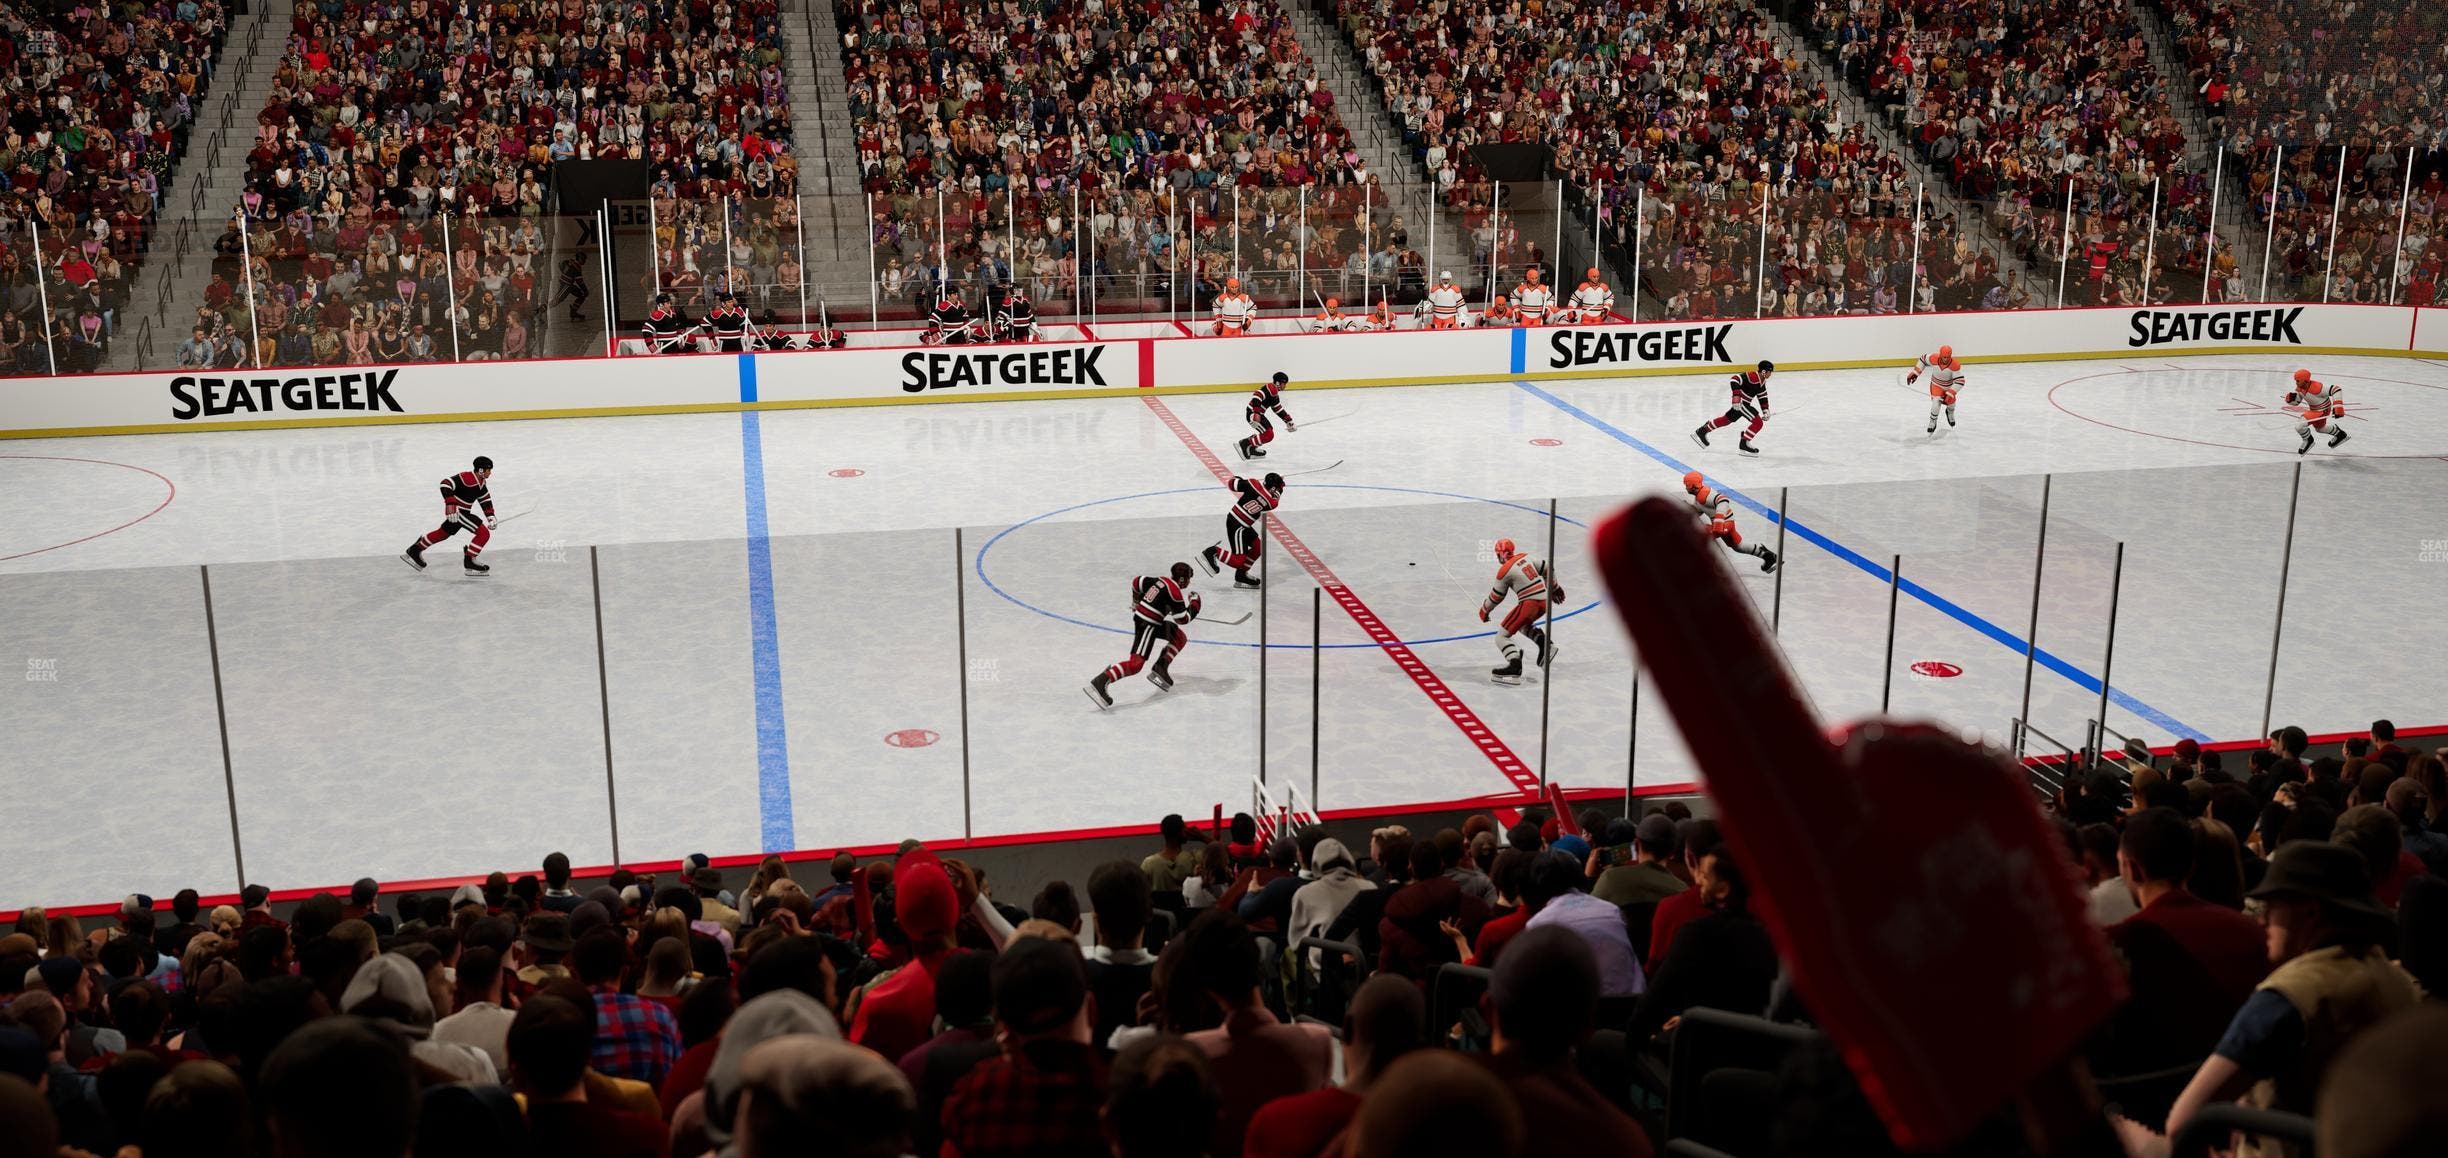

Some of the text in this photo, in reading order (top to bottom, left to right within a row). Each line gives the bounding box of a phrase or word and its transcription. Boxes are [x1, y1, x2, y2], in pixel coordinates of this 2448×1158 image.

[1550, 324, 1733, 369] SEATGEEK
[2128, 306, 2304, 347] SEATGEEK
[902, 345, 1107, 393] SEATGEEK
[170, 369, 405, 420] SEATGEEK
